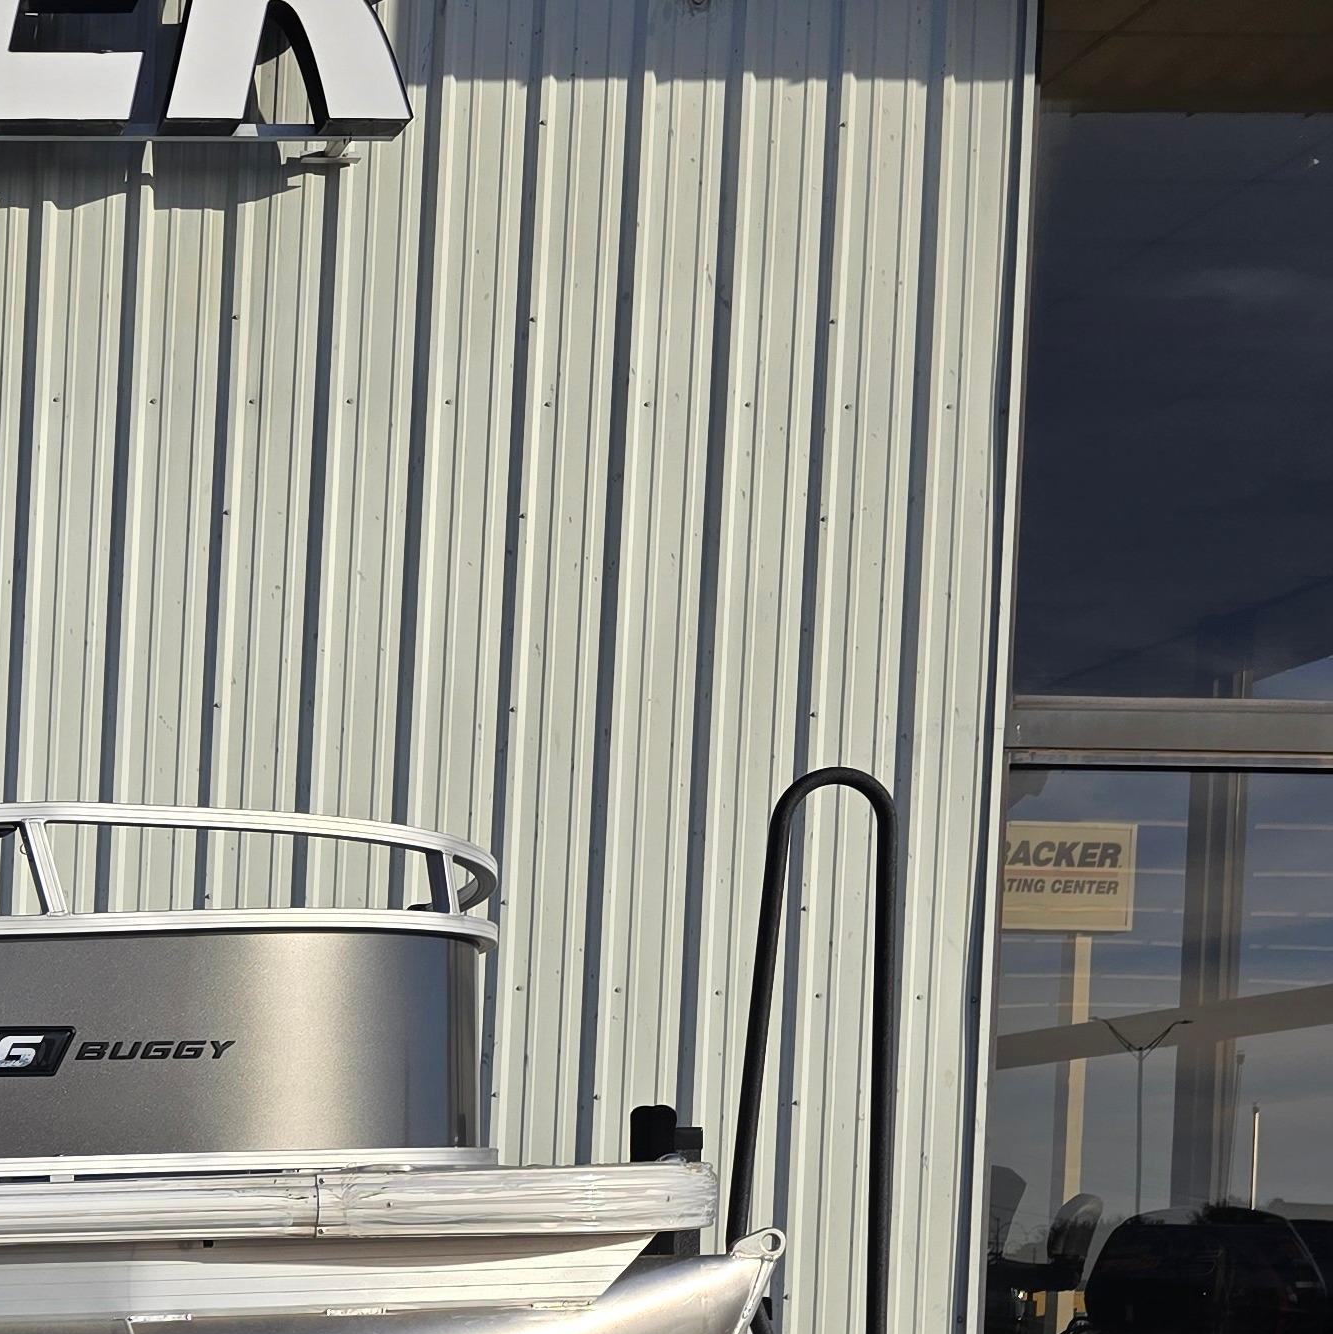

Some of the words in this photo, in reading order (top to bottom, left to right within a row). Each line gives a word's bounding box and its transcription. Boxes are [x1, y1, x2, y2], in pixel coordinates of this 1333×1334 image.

[1002, 878, 1046, 893] TING
[1051, 880, 1119, 895] CENTER
[75, 1040, 235, 1060] BUGGY
